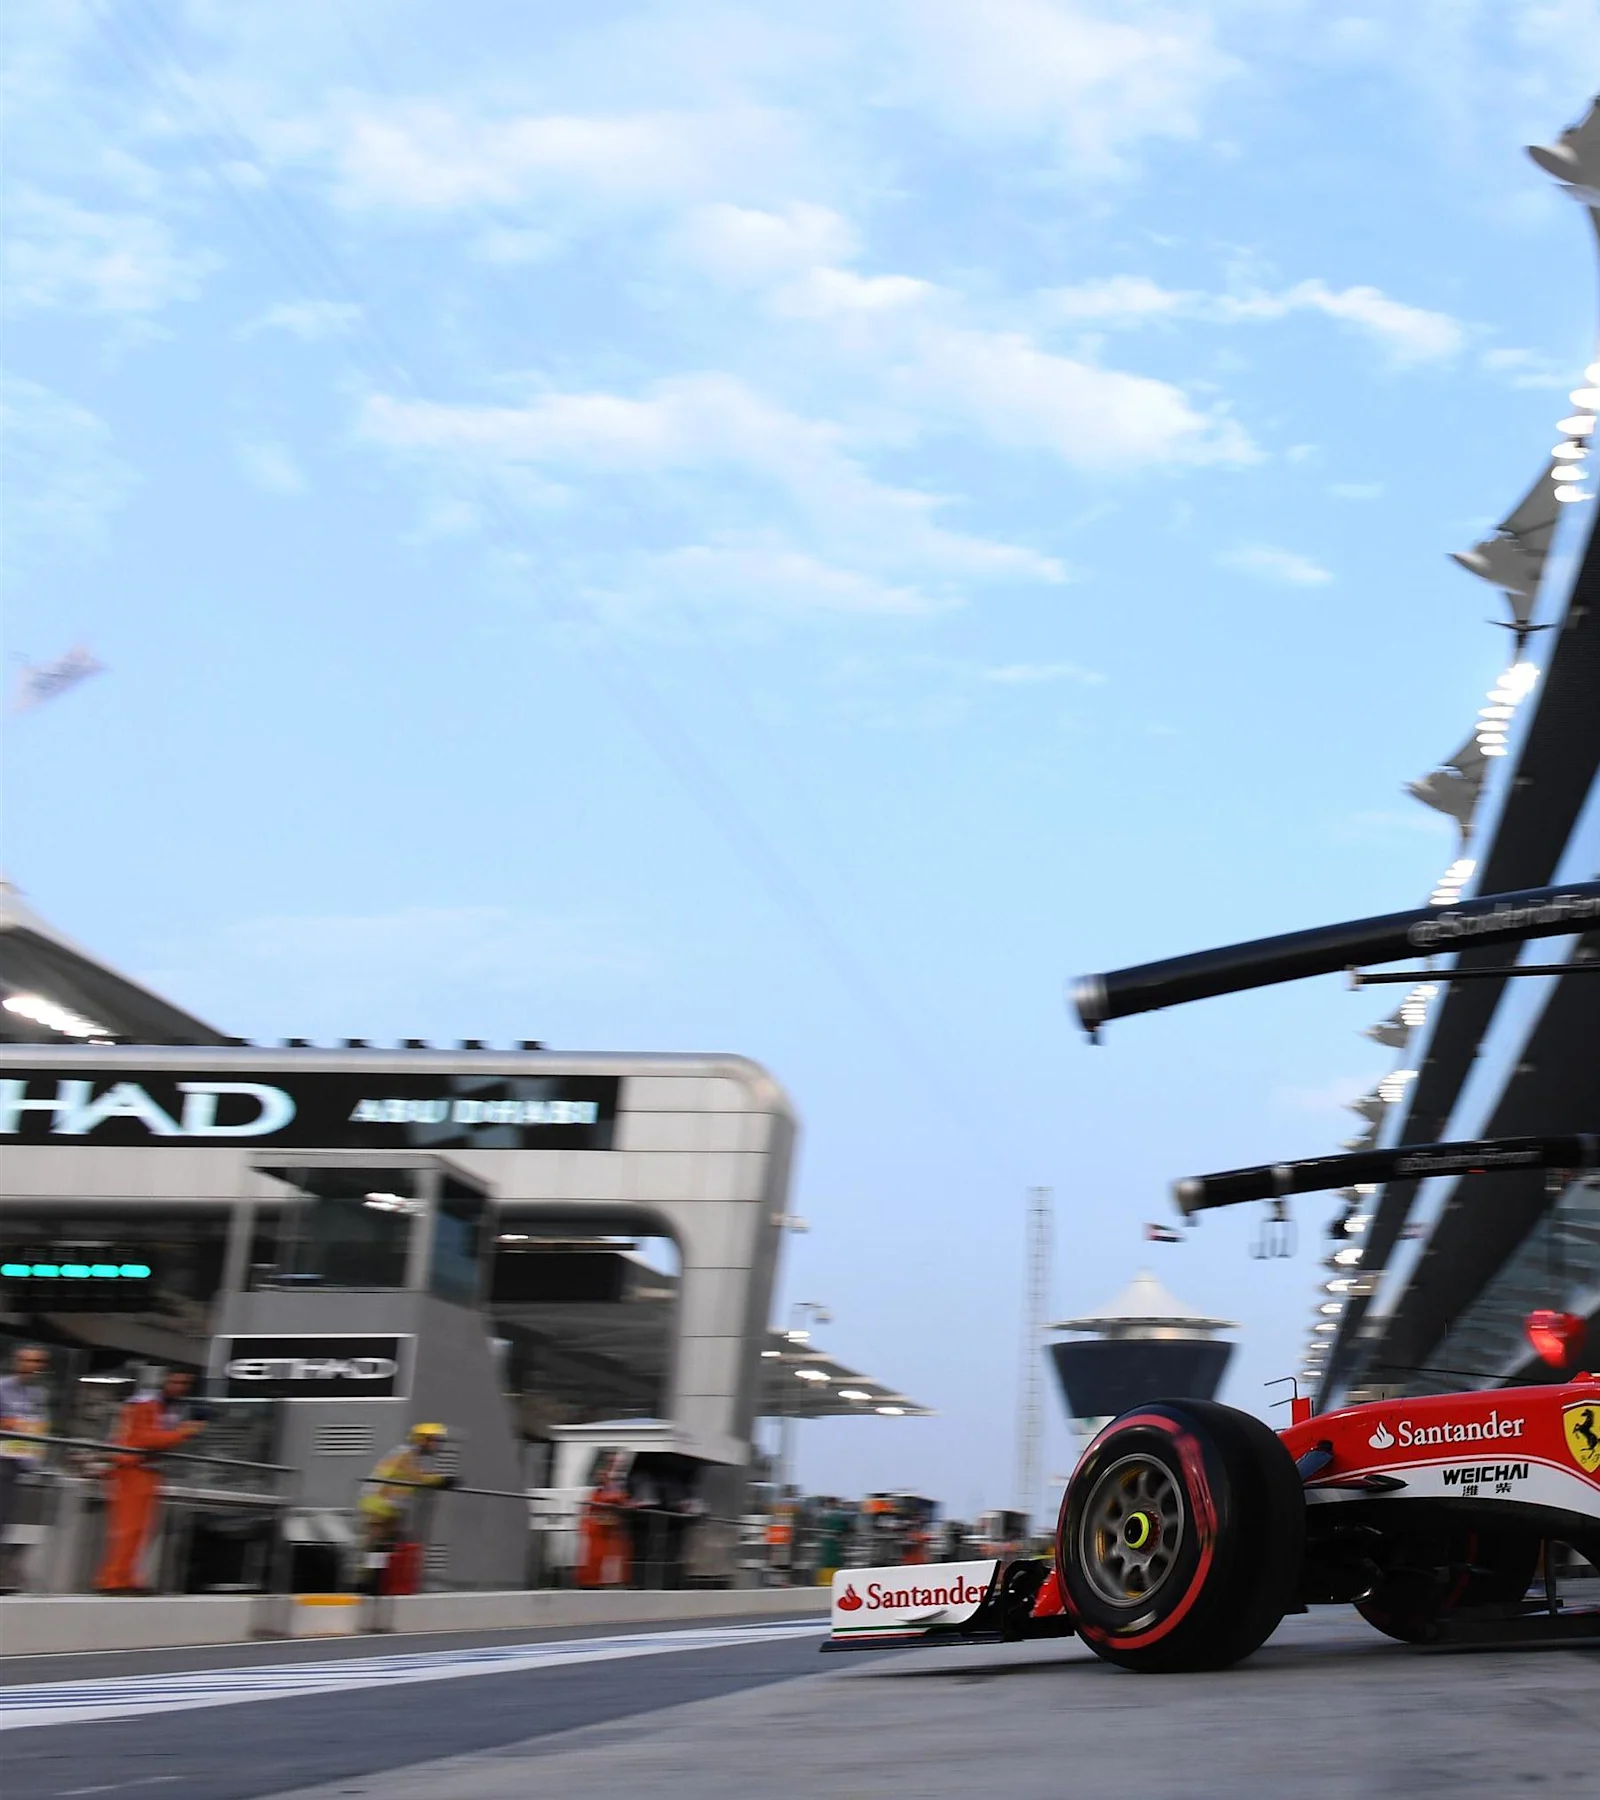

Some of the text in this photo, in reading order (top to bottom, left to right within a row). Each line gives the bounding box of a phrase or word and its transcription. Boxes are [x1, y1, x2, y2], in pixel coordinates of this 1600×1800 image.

[1398, 1410, 1525, 1447] Santander
[1442, 1463, 1529, 1485] WEICHAI
[867, 1575, 988, 1609] Santander
